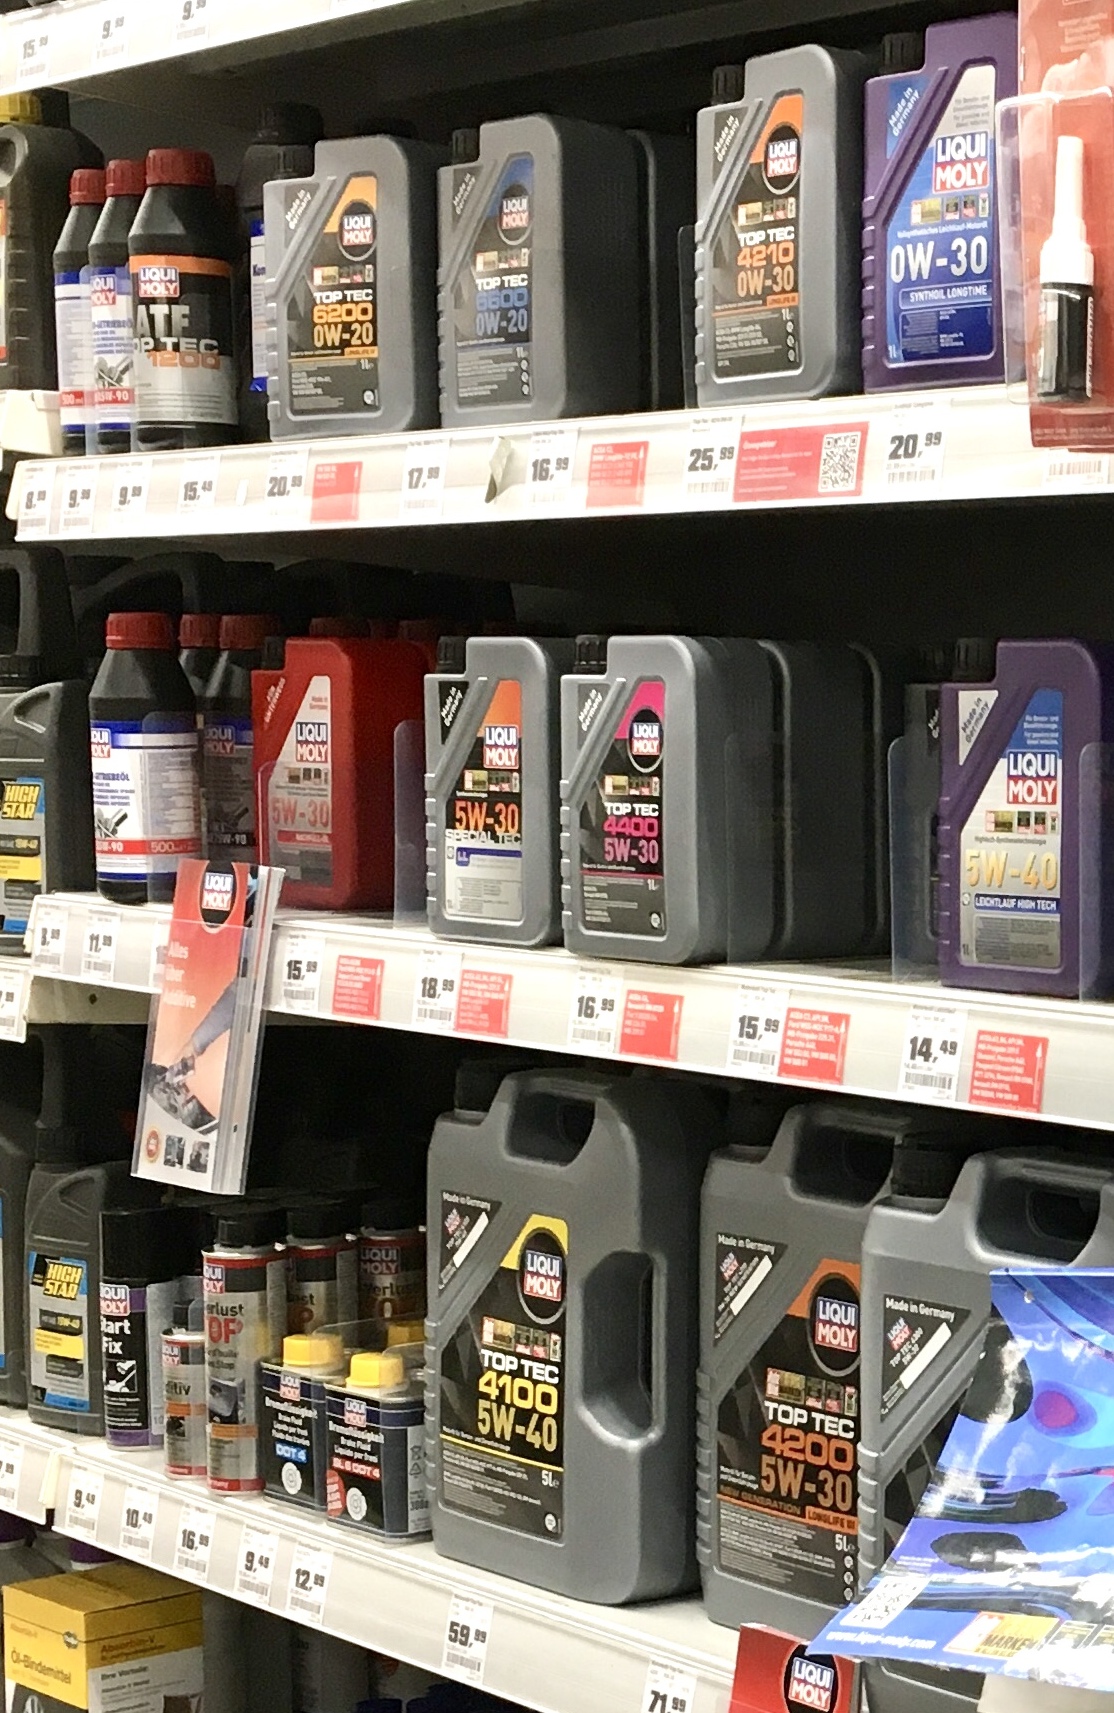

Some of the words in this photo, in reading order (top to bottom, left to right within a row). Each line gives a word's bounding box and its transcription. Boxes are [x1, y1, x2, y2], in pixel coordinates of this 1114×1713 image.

[888, 95, 907, 127] Made
[892, 90, 920, 136] Germany
[768, 140, 796, 158] LIQUI
[936, 134, 986, 162] LIQUI
[767, 158, 797, 176] MOLY
[936, 160, 988, 190] MOLY
[502, 197, 528, 212] LIQUI
[342, 216, 372, 230] LIQUI
[502, 212, 528, 229] MOLY
[342, 230, 373, 245] MOLY
[738, 231, 766, 248] TOP
[768, 226, 795, 244] TEC
[738, 242, 794, 268] 4210
[890, 236, 988, 283] 0W-30
[140, 267, 176, 280] LIQUI
[476, 276, 502, 290] TOP
[502, 274, 528, 288] TEC
[738, 264, 794, 298] 0W-30
[140, 282, 178, 296] MOLY
[314, 290, 343, 304] TOP
[344, 288, 373, 300] TEC
[910, 288, 946, 302] SYNTHOIL
[947, 284, 988, 298] LONGTIME
[136, 304, 190, 338] ATF
[313, 303, 373, 323] 6200
[476, 308, 528, 336] 0W-20
[158, 337, 219, 354] TEC
[314, 322, 374, 348] 0W-20
[146, 350, 221, 370] 1200
[888, 432, 942, 460] 20,99
[532, 457, 569, 482] 16,99
[688, 446, 734, 472] 25,99
[267, 475, 302, 497] 20,99
[408, 466, 440, 490] 17,99
[183, 480, 213, 501] 15,49
[581, 692, 603, 732] Germany
[965, 702, 990, 744] Germany
[296, 724, 327, 740] LIQUI
[486, 727, 517, 746] LIQUI
[633, 724, 658, 738] LIQUI
[296, 744, 328, 762] MOLY
[486, 747, 518, 766] MOLY
[632, 738, 659, 754] MOLY
[1009, 753, 1056, 777] LIQUI
[5, 784, 40, 802] HIGH
[1008, 780, 1057, 803] MOLY
[2, 802, 36, 820] STAR
[272, 798, 330, 827] 5W-30
[455, 800, 518, 833] 5W-30
[605, 802, 631, 816] TOP
[633, 804, 659, 816] TEC
[446, 828, 493, 844] SPECIAL
[498, 832, 522, 844] TEC
[604, 816, 659, 838] 4400
[151, 842, 174, 853] 500
[604, 838, 659, 864] 5W-30
[205, 874, 233, 890] LIQUI
[965, 850, 1058, 891] 5W-40
[202, 890, 232, 910] MOLY
[1017, 898, 1036, 910] HIGH
[1036, 898, 1056, 912] TECH
[286, 959, 318, 982] 15,99
[420, 976, 456, 1000] 18,99
[577, 995, 615, 1021] 16,99
[738, 1014, 780, 1040] 15,99
[910, 1036, 958, 1063] 14,49
[361, 1249, 397, 1260] LIQUI
[718, 1234, 737, 1247] Made
[745, 1238, 776, 1255] Germany
[48, 1262, 83, 1284] HIGH
[526, 1253, 560, 1277] LIQUI
[44, 1280, 78, 1299] STAR
[524, 1274, 562, 1301] MOLY
[818, 1299, 856, 1327] LIQUI
[886, 1297, 909, 1312] Made
[910, 1302, 918, 1314] in
[918, 1303, 955, 1323] Germany
[816, 1324, 857, 1351] MOLY
[482, 1349, 520, 1373] TOP
[520, 1358, 559, 1384] TEC
[478, 1370, 558, 1416] 4100
[478, 1398, 557, 1452] 5W-40
[764, 1401, 810, 1425] TOP
[814, 1413, 855, 1439] TEC
[276, 1443, 296, 1459] DOT
[298, 1449, 306, 1462] 4
[760, 1424, 854, 1471] 4200
[352, 1463, 372, 1476] DOT
[761, 1454, 853, 1512] 5W-30
[244, 1550, 270, 1573] 9,49
[294, 1568, 325, 1592] 12,99
[448, 1620, 487, 1648] 59,99
[10, 1647, 72, 1684] Öl-Bindemittel
[795, 1658, 834, 1687] LIQUI
[649, 1689, 686, 1713] 71,99
[790, 1680, 832, 1712] MOLY
